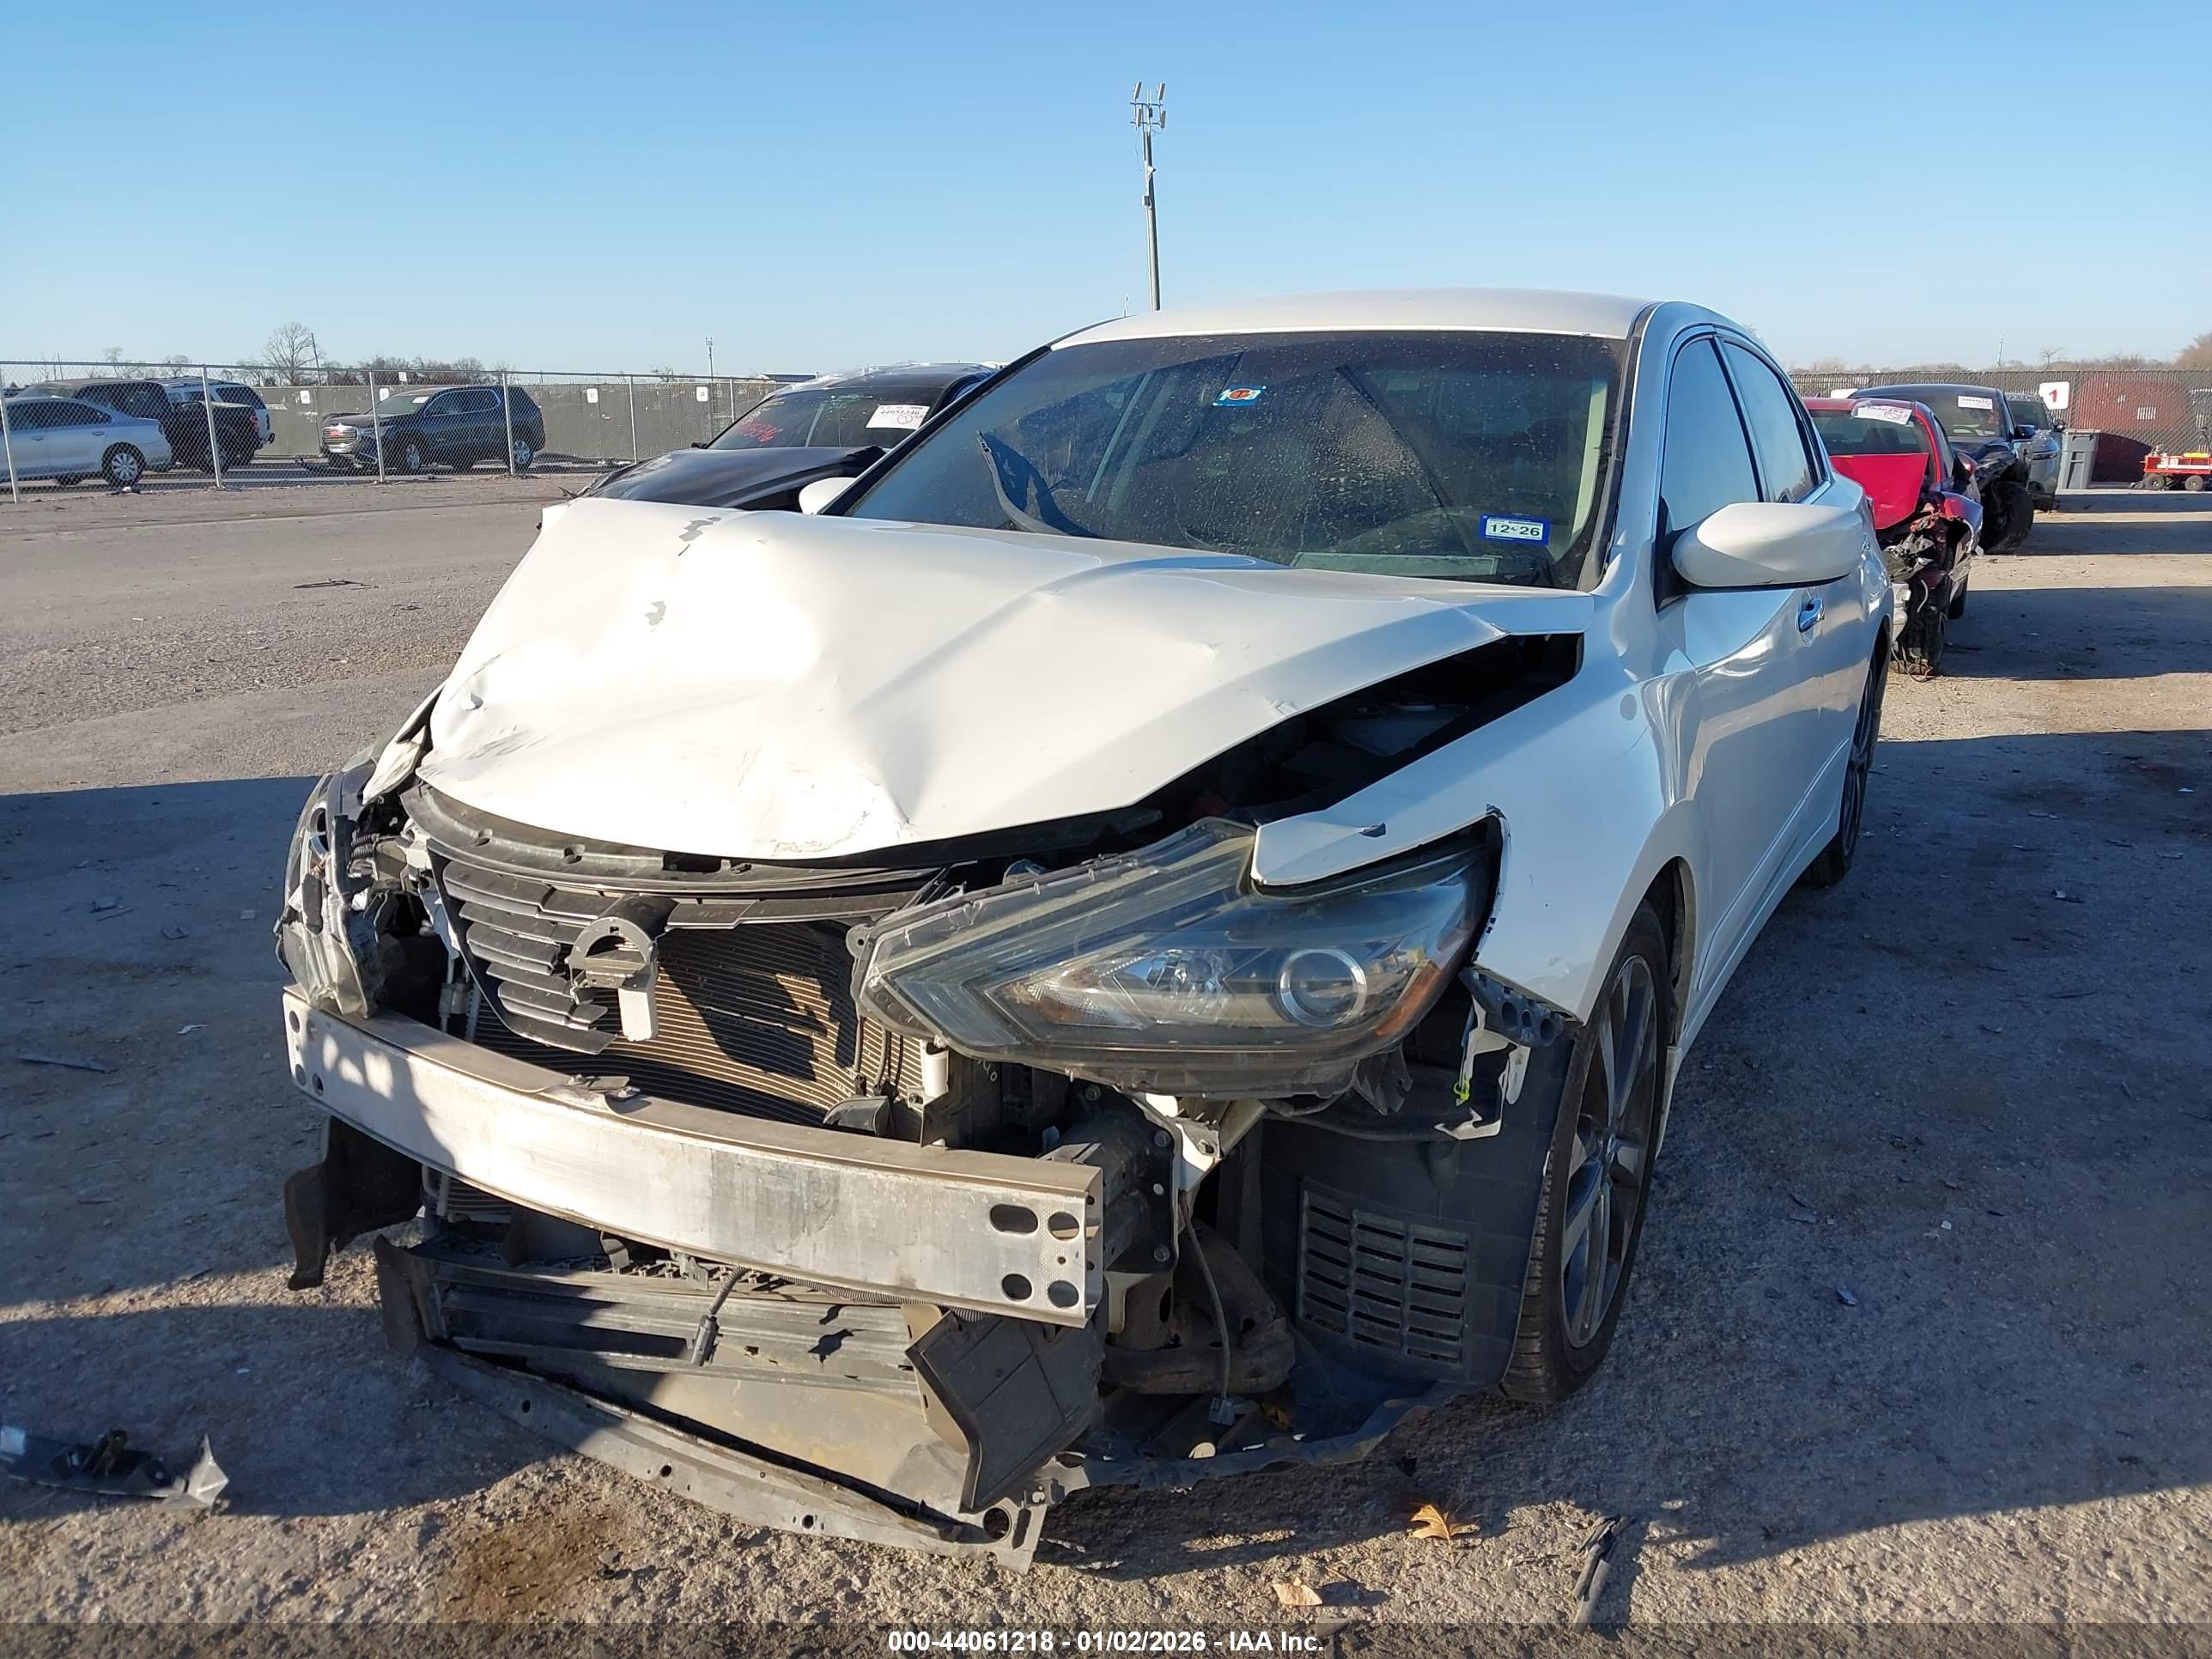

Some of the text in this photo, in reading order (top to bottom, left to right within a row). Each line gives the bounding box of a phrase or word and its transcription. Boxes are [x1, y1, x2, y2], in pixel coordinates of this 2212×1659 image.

[2049, 389, 2057, 403] 1
[1490, 524, 1540, 536] 12 26
